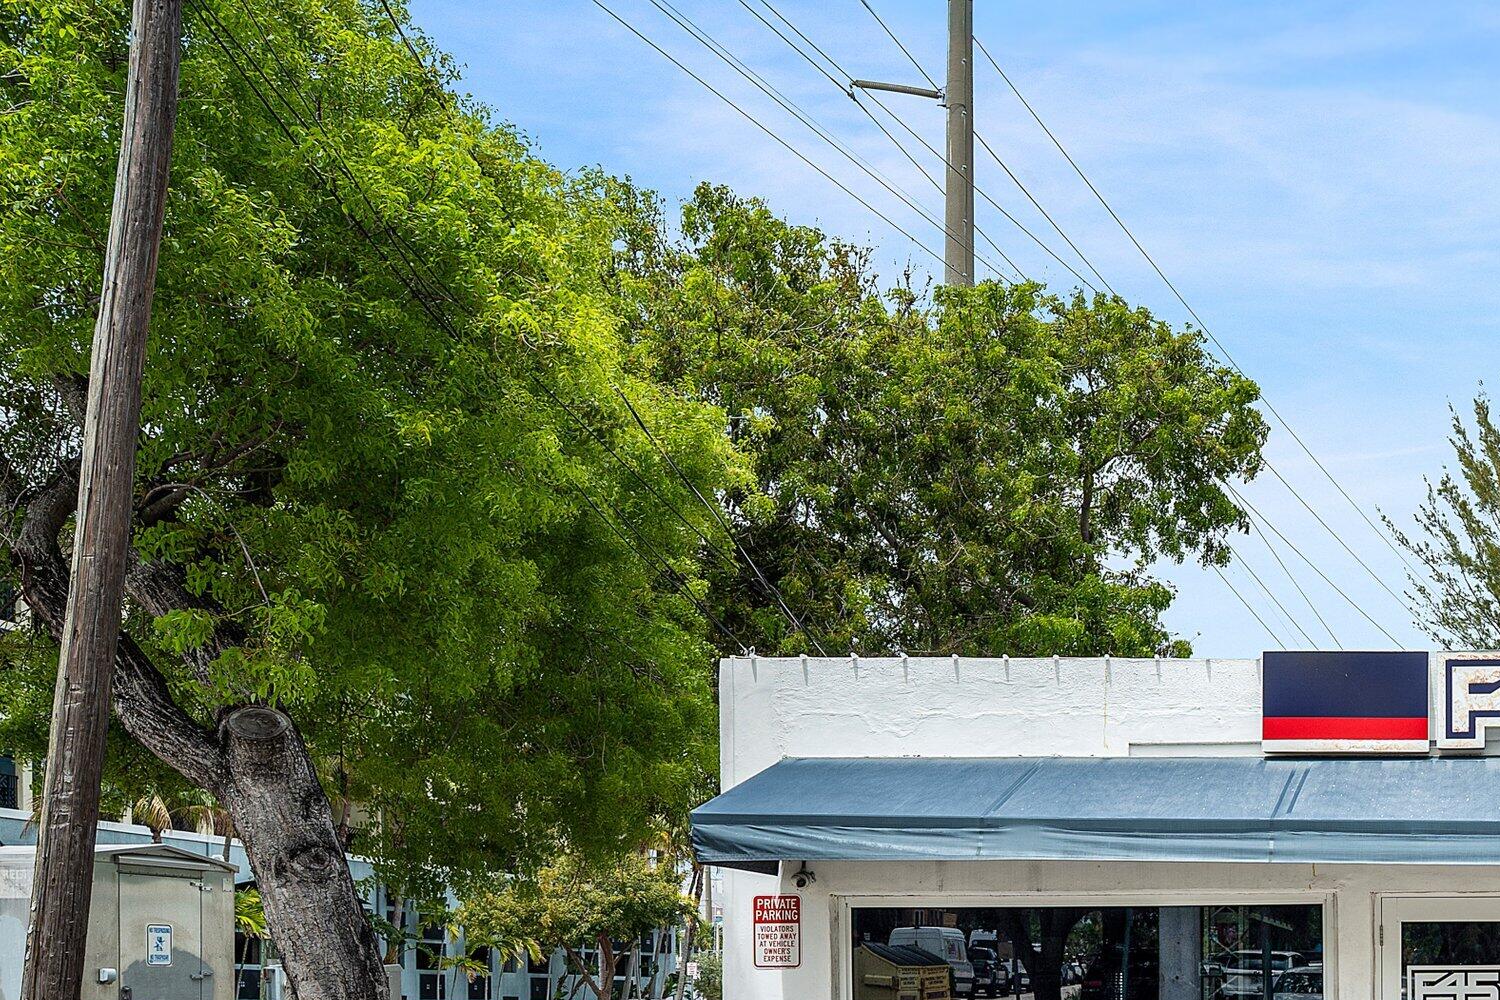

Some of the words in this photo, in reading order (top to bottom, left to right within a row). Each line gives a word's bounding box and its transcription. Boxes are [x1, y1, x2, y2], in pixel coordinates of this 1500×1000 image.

[757, 898, 797, 909] PRIVATE
[755, 909, 798, 921] PARKING
[760, 925, 794, 933] VIOLATORS
[759, 940, 767, 948] AT
[769, 940, 795, 948] VEHICLE
[763, 955, 792, 963] EXPENSE
